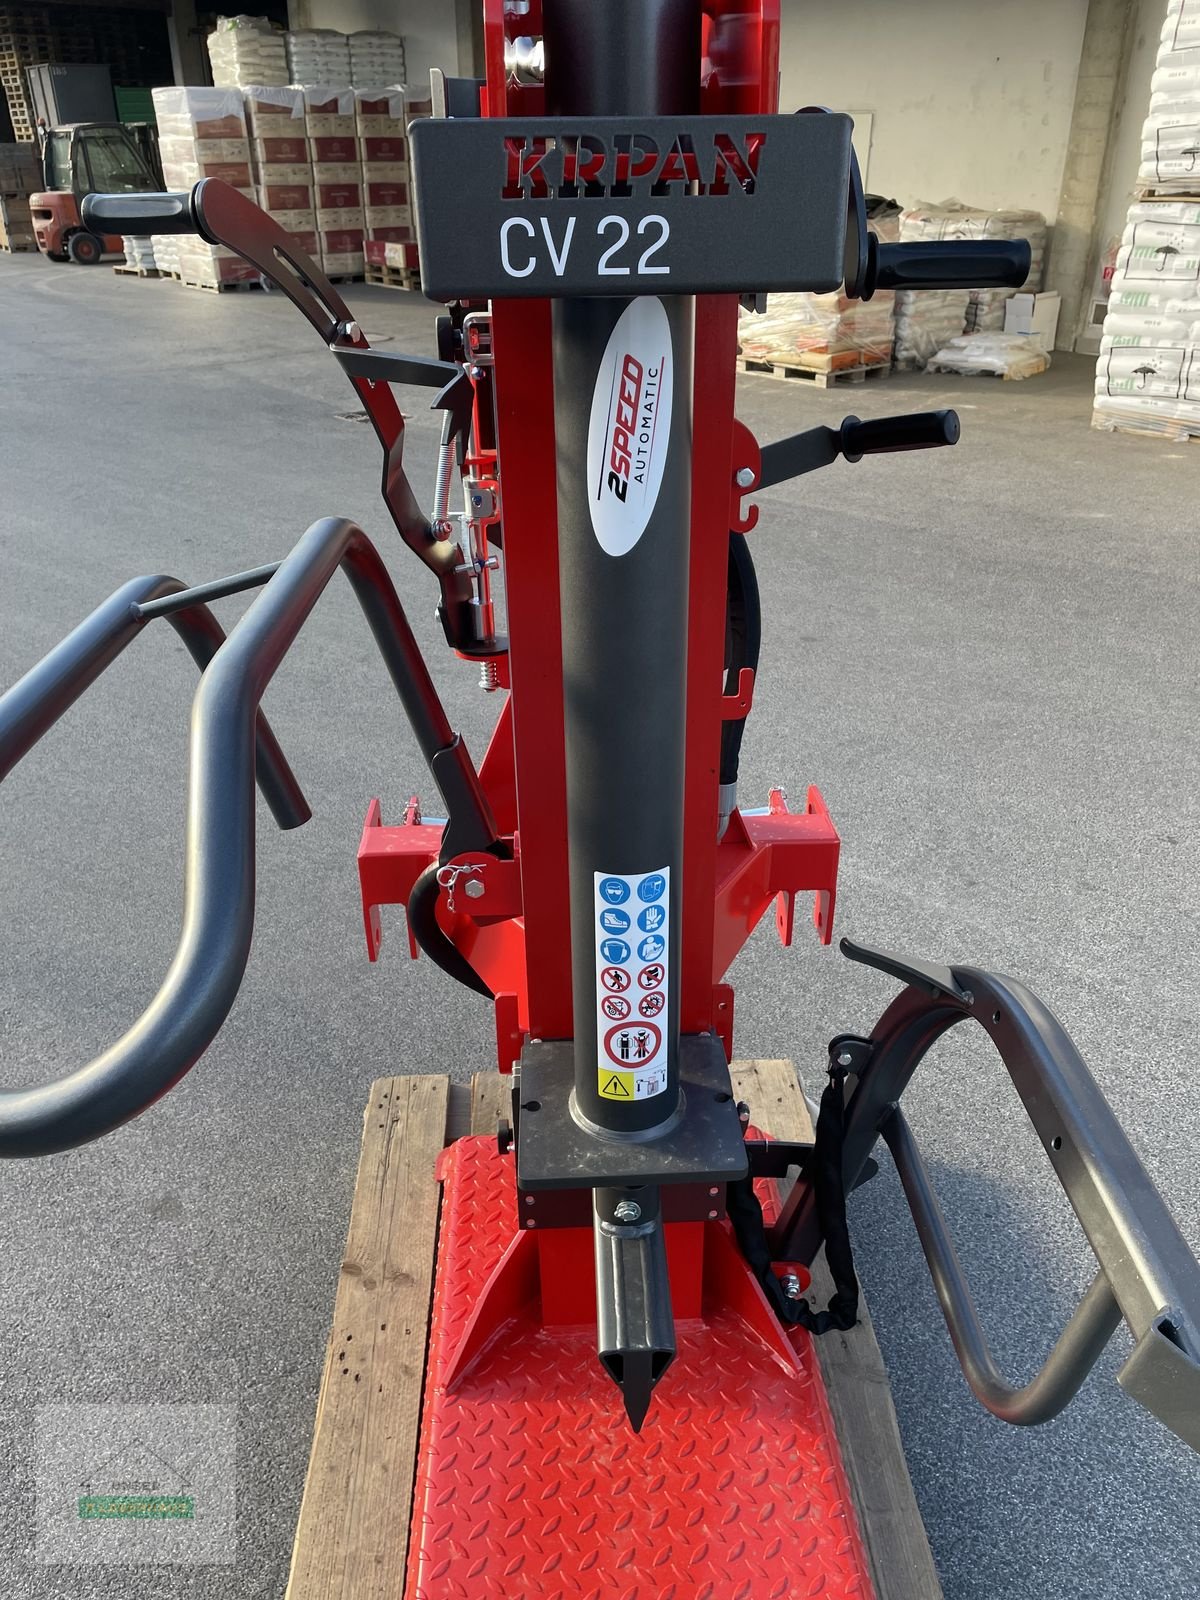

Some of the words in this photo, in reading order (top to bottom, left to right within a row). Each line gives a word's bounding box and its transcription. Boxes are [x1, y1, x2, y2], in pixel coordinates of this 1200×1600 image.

[500, 132, 767, 200] KRPAN
[499, 215, 576, 278] CV
[597, 214, 671, 276] 22
[607, 353, 644, 504] 2SPEED
[634, 367, 659, 484] AUTOMATIC
